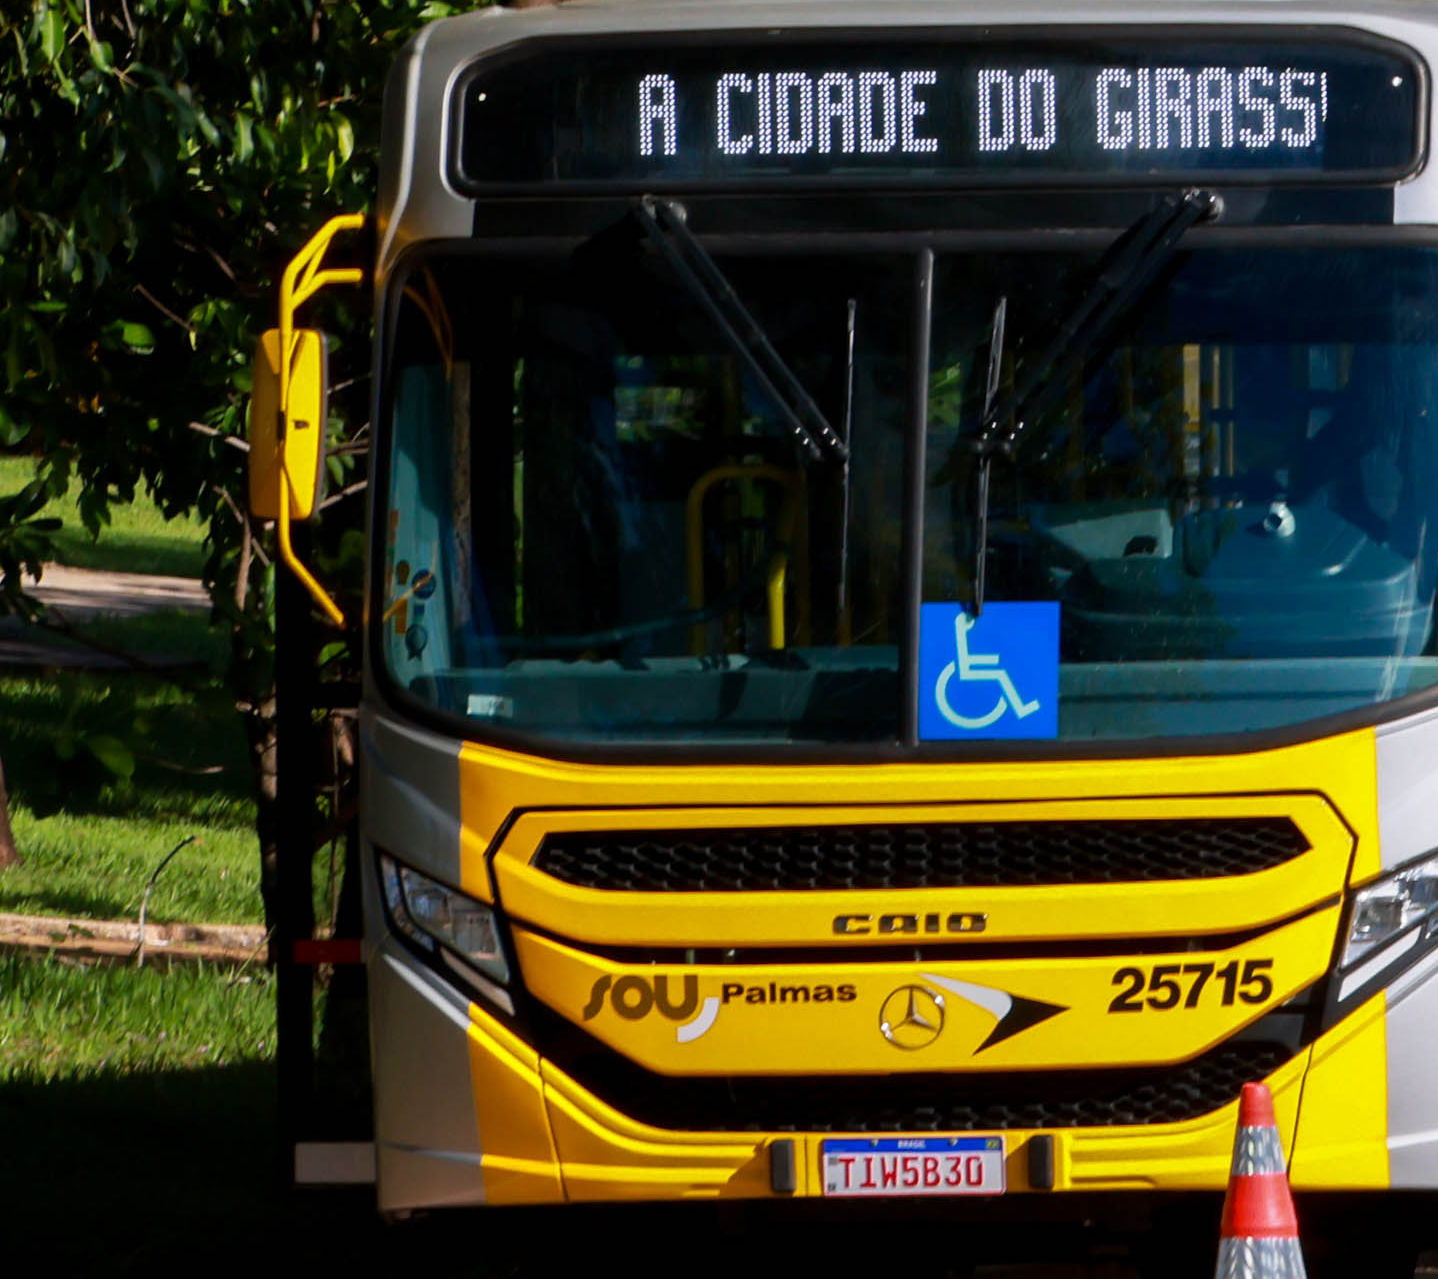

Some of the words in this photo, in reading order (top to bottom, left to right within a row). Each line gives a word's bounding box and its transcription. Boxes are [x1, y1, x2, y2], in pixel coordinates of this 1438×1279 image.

[639, 73, 677, 155] A
[717, 70, 938, 156] CIDADE
[977, 68, 1056, 152] DO
[1096, 66, 1329, 150] GIRASS
[832, 913, 989, 935] CAIO
[722, 982, 857, 1005] Palmas
[1108, 959, 1274, 1014] 25715
[897, 1140, 926, 1149] BRASIL
[838, 1156, 983, 1188] TIW5B30
